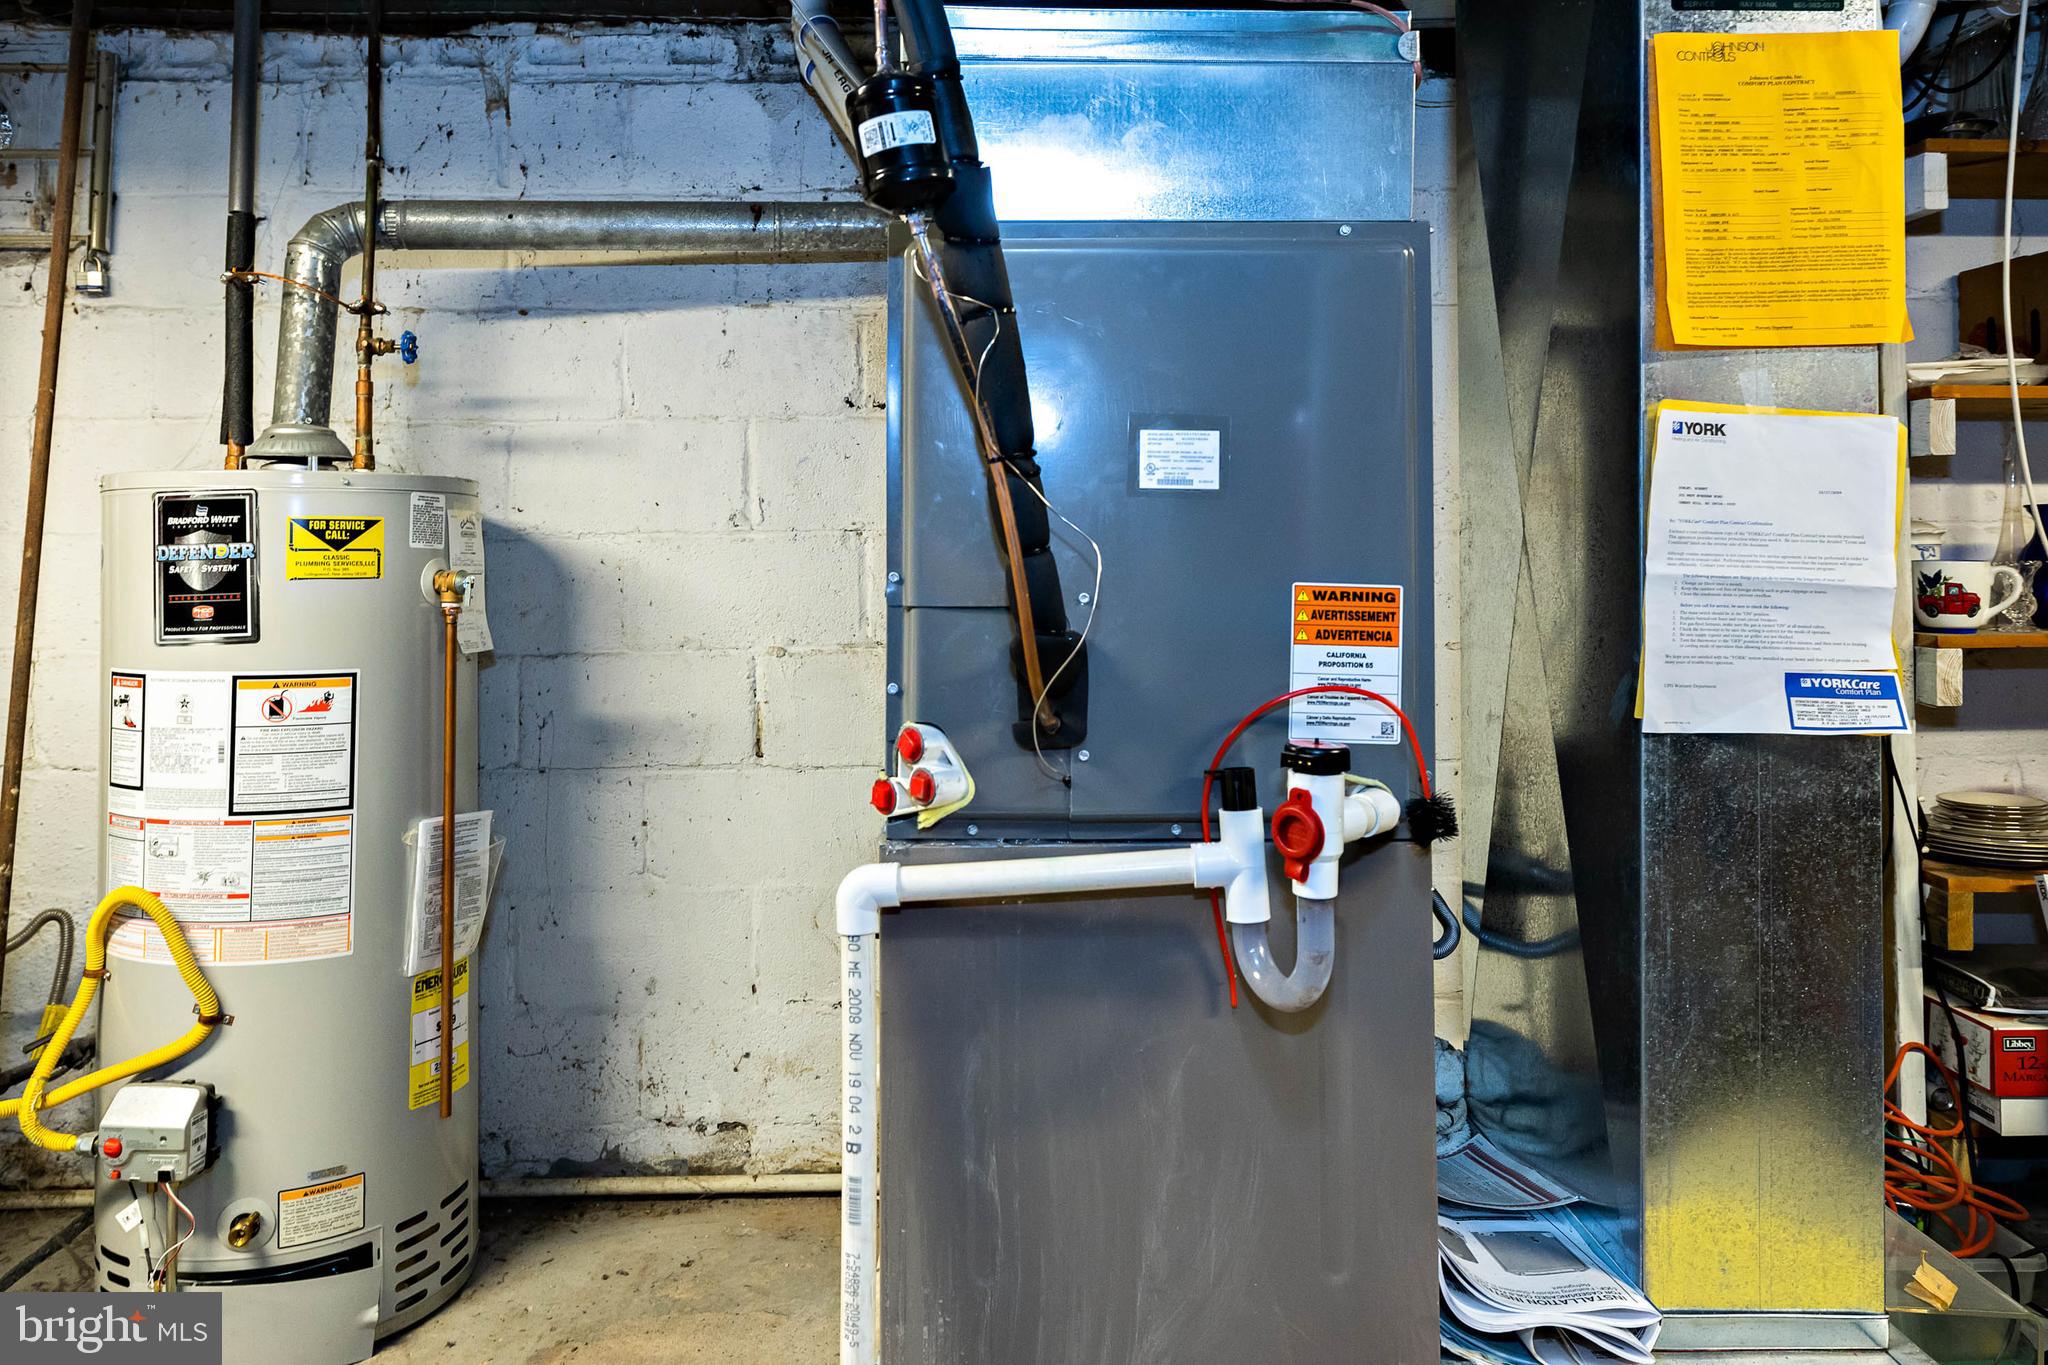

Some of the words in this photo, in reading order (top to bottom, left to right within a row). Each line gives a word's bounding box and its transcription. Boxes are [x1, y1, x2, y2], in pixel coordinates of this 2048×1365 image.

[1706, 41, 1764, 52] JOHNSON
[1676, 51, 1736, 62] CONTROLS
[1685, 421, 1727, 436] YORK
[168, 516, 209, 525] BRADFORD
[210, 515, 240, 523] WHITE
[309, 520, 326, 530] FOR
[329, 520, 365, 530] SERVICE
[325, 530, 350, 540] CALL:
[157, 542, 255, 561] DEFENDER
[169, 564, 199, 574] SAFETY
[200, 564, 236, 573] SYSTEM
[1312, 590, 1396, 603] WARNING
[1311, 609, 1396, 622] AVERTISSEMENT
[1315, 629, 1392, 642] ADVERTENCIA
[1318, 661, 1364, 669] PROPOSITION
[1811, 678, 1880, 689] YORKCare
[848, 961, 861, 979] ME
[848, 988, 862, 1024] 2008
[2006, 1039, 2032, 1050] Libbey
[848, 1071, 862, 1087] 19
[846, 1140, 862, 1154] B
[309, 1183, 342, 1196] WARNING
[1524, 1294, 1627, 1306] INSTALLATION
